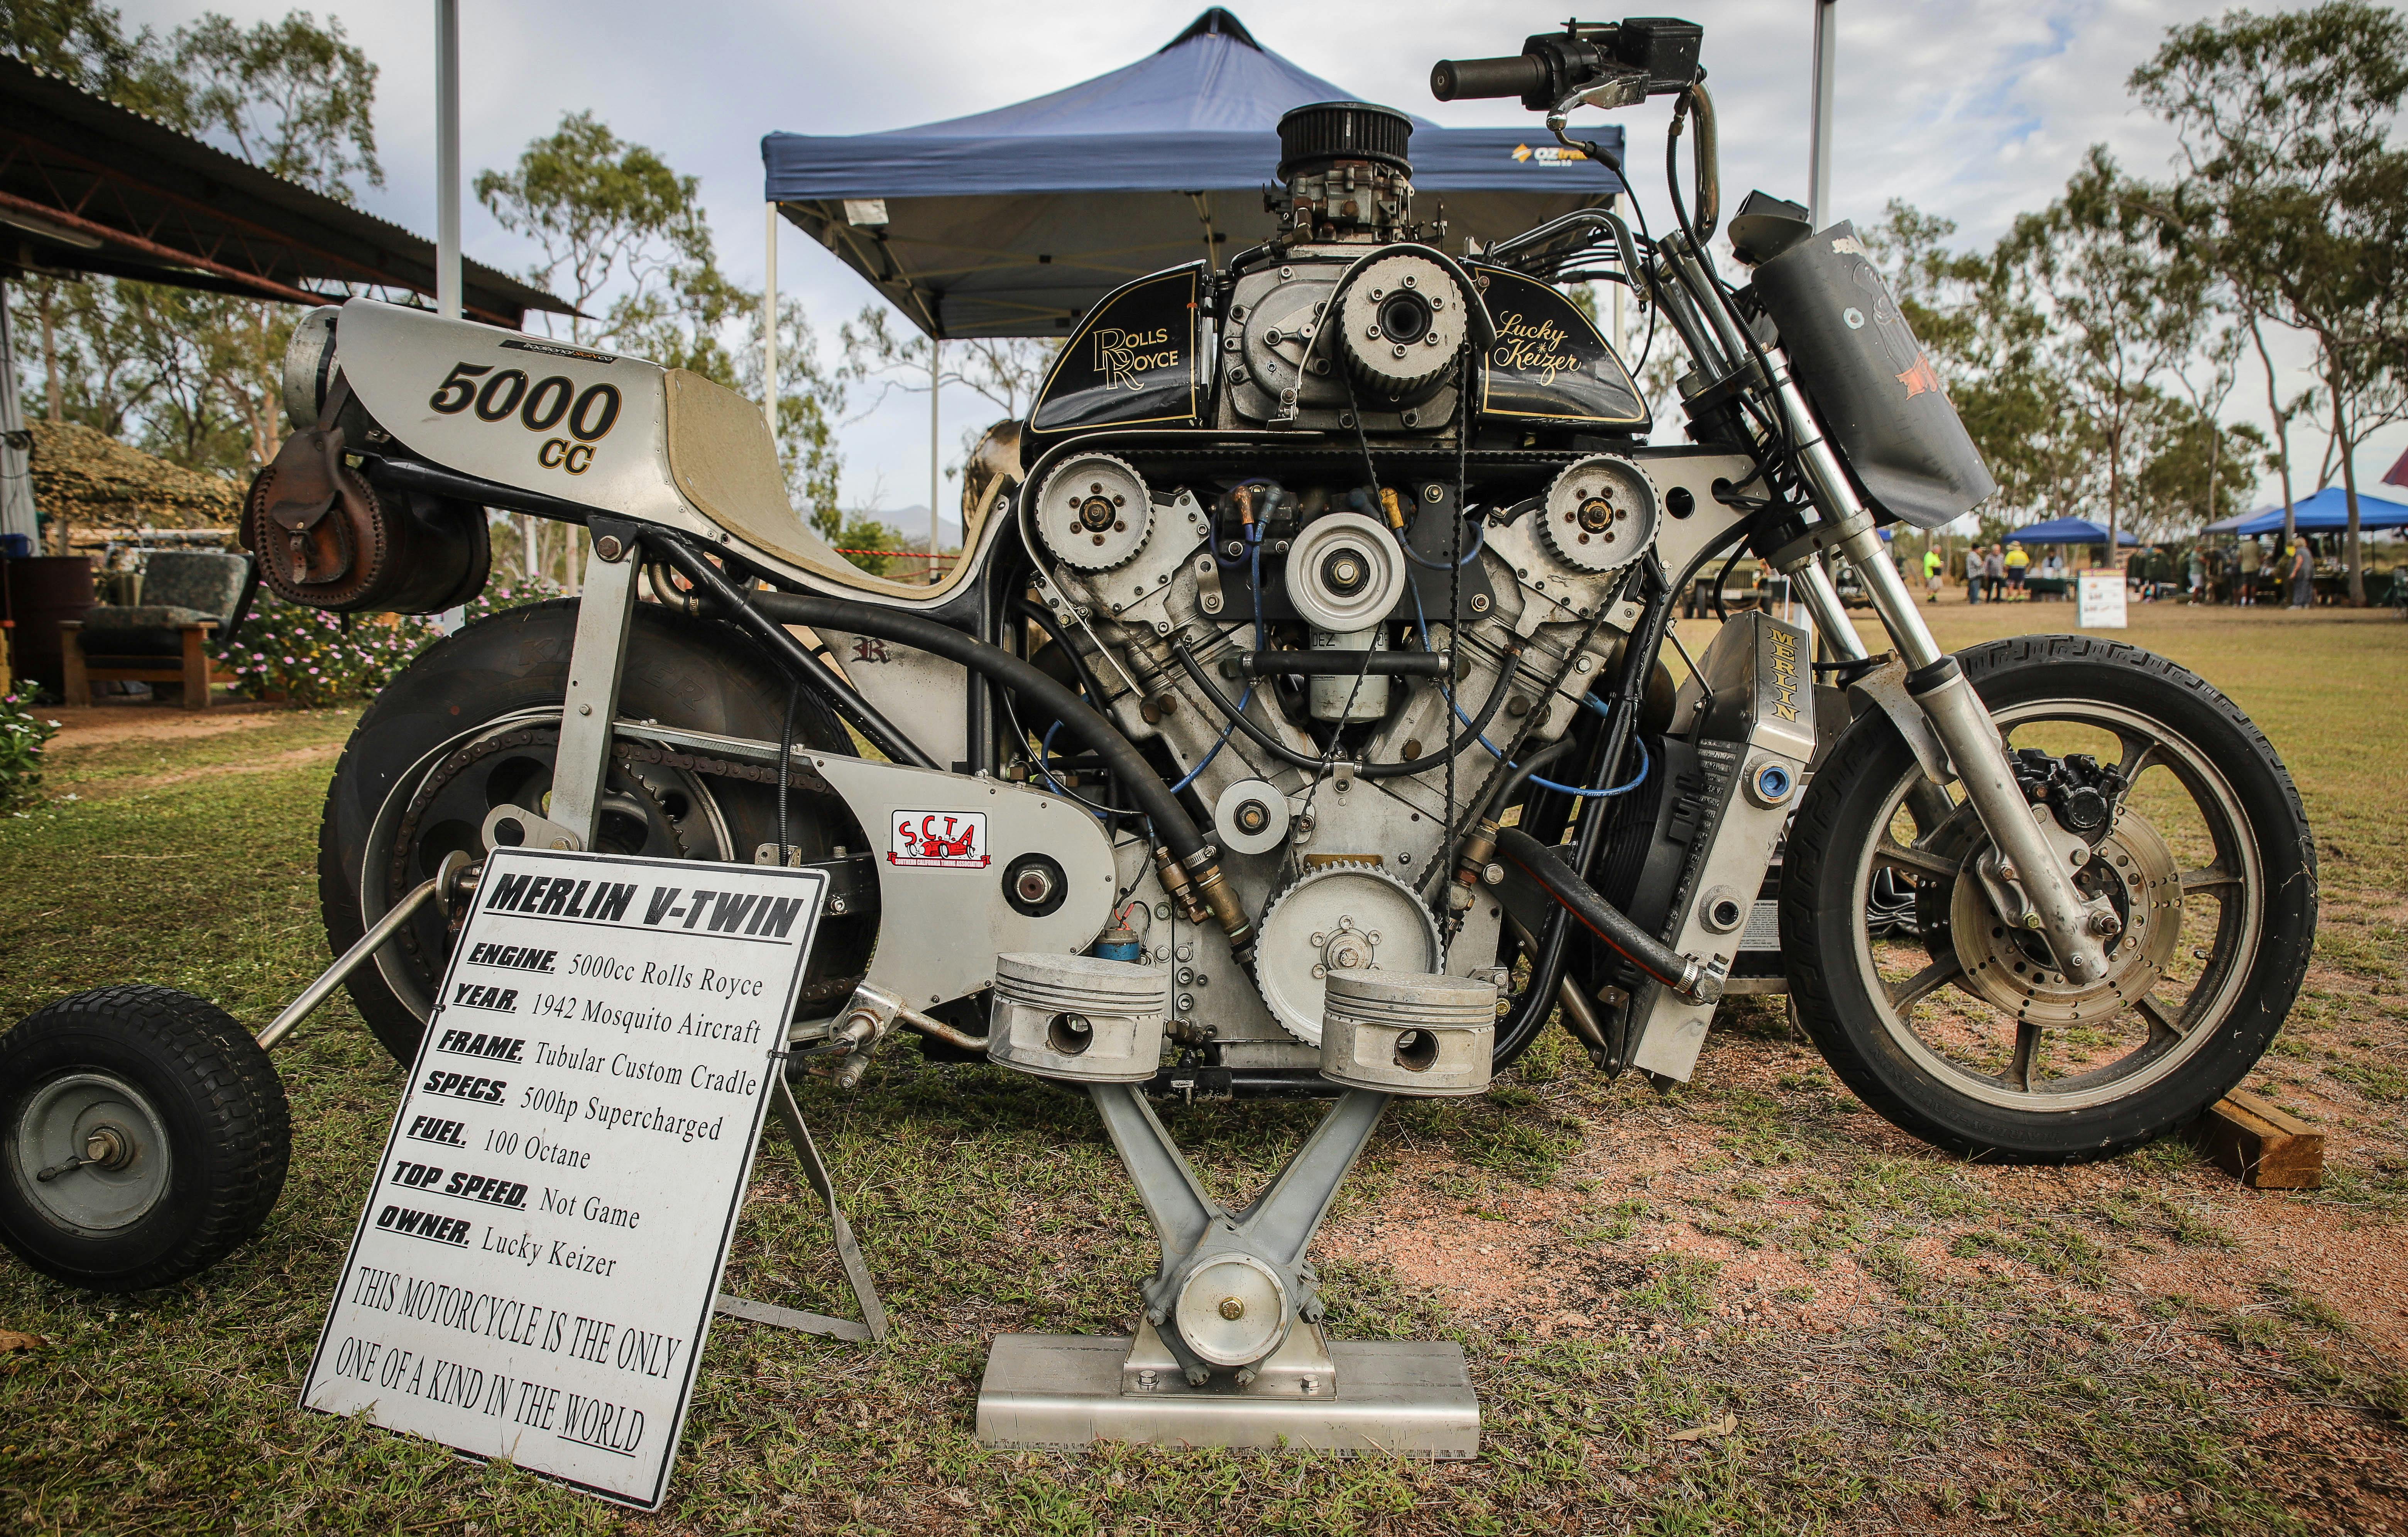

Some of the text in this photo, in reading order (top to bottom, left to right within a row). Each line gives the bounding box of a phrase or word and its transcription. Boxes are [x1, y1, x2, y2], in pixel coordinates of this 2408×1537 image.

[1093, 328, 1167, 371] ROLLS
[1494, 338, 1581, 386] Keizer
[1496, 310, 1568, 352] Lucky
[429, 361, 622, 443] 5000
[1104, 349, 1179, 391] ROYCE
[1767, 626, 1801, 723] MERLIN
[485, 873, 804, 938] MERLIN V-TWIN
[468, 943, 762, 999] ENGINE. 5000cc Rolls Royce
[453, 983, 761, 1043] YEAR. 1942 Mosquito Aircraft
[437, 1029, 756, 1095] FRAME. Tubular Custom Cradle
[424, 1071, 723, 1142] SPECS. 500hp Supercharged
[408, 1116, 590, 1168] FUEL. 100 Octane
[391, 1161, 639, 1229] TOP SPEED. Not Game
[377, 1205, 616, 1276] OWNER. Lucky Keizer
[352, 1266, 682, 1379] THIS MOTORCYCLE IS THE ONLY
[337, 1337, 644, 1452] ONE OF A KIND IN THE WORLD
